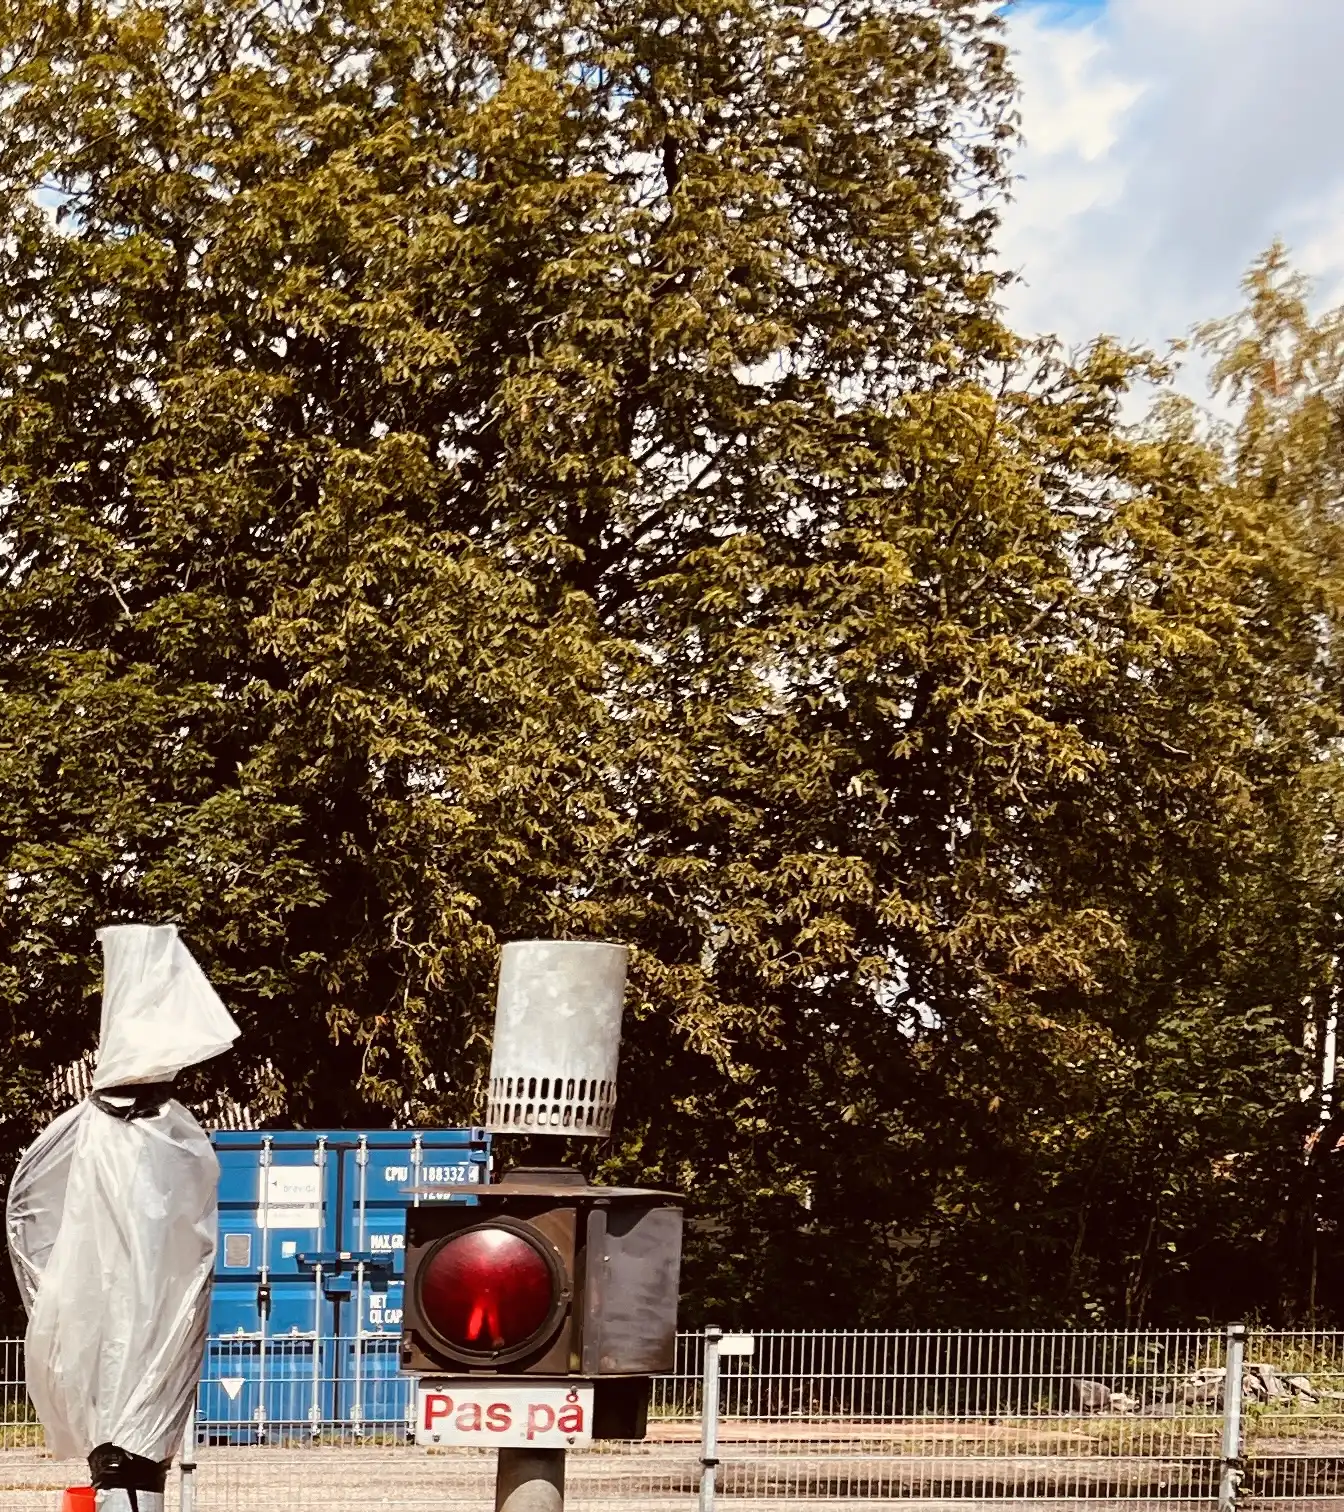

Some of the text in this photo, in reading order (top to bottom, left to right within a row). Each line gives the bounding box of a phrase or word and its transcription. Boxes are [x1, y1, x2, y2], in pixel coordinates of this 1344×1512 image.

[422, 1166, 465, 1181] 188332
[424, 1393, 584, 1440] Pas på
